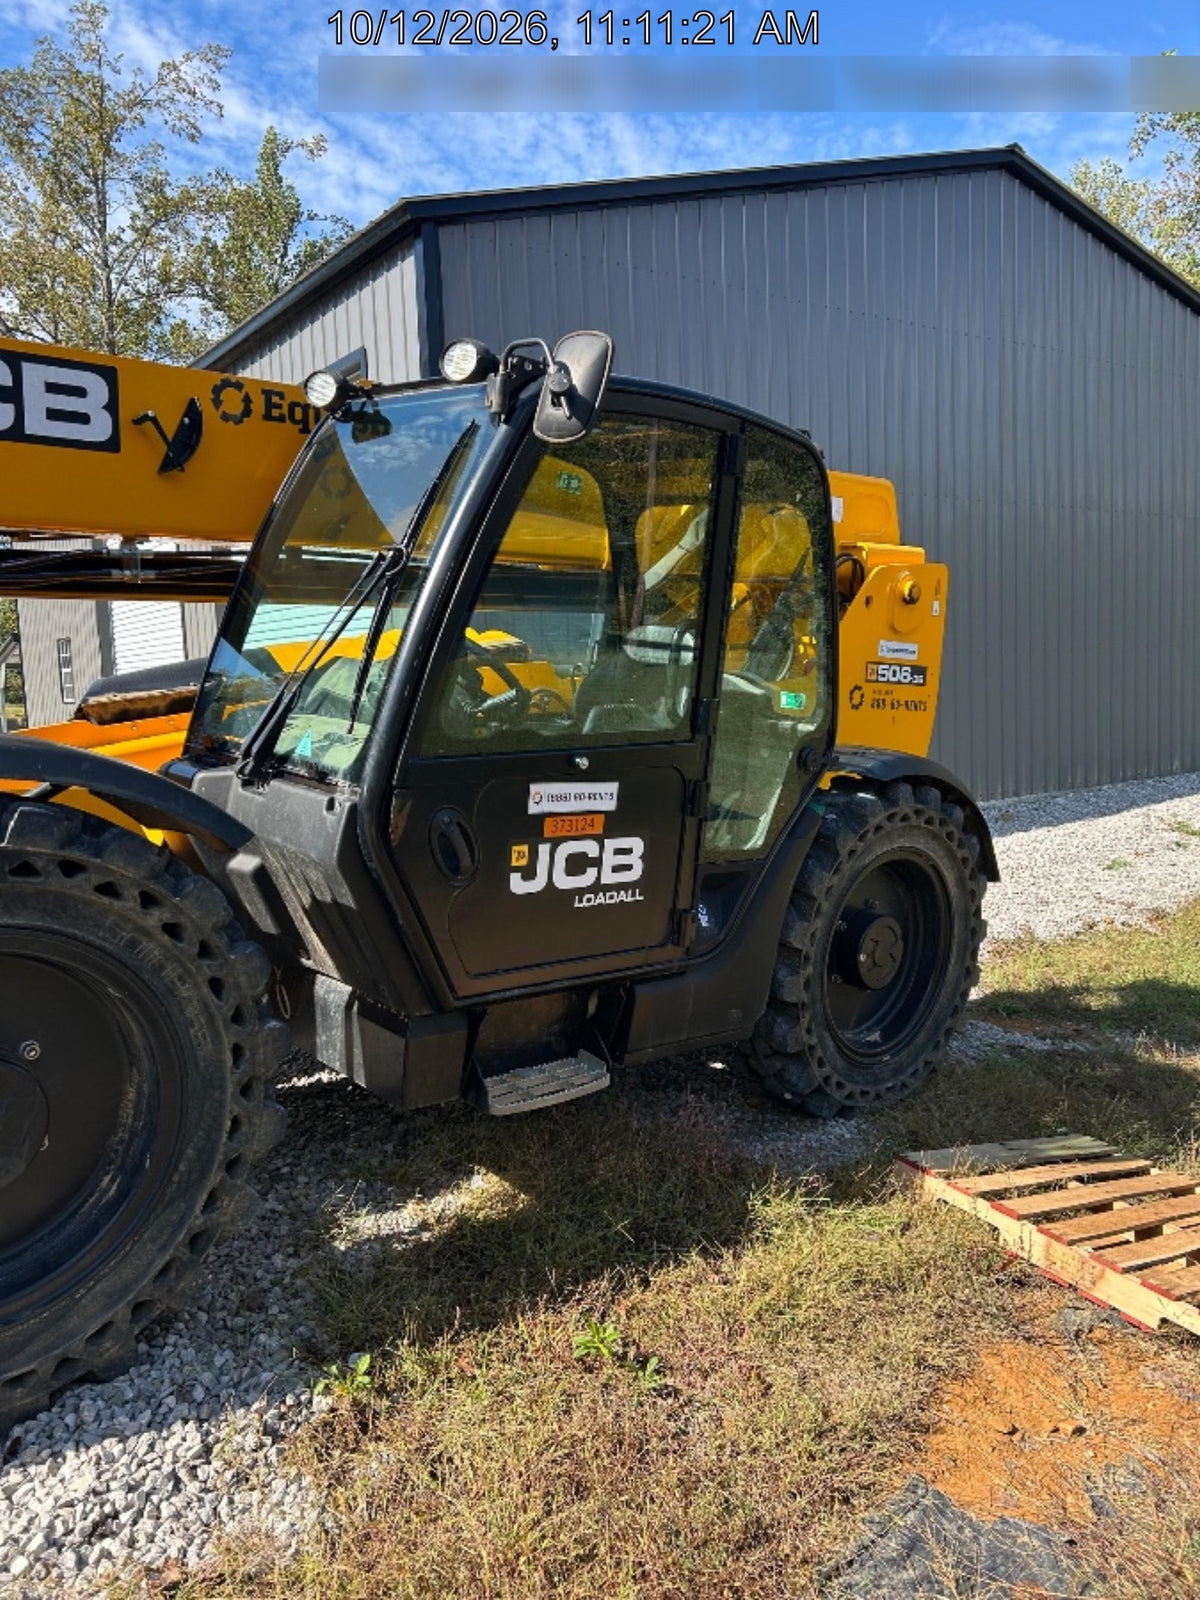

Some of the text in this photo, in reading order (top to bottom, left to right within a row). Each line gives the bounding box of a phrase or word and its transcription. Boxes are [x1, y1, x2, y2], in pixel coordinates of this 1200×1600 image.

[550, 817, 596, 834] 373124
[509, 836, 645, 895] JCB
[573, 888, 645, 908] LOADALL
